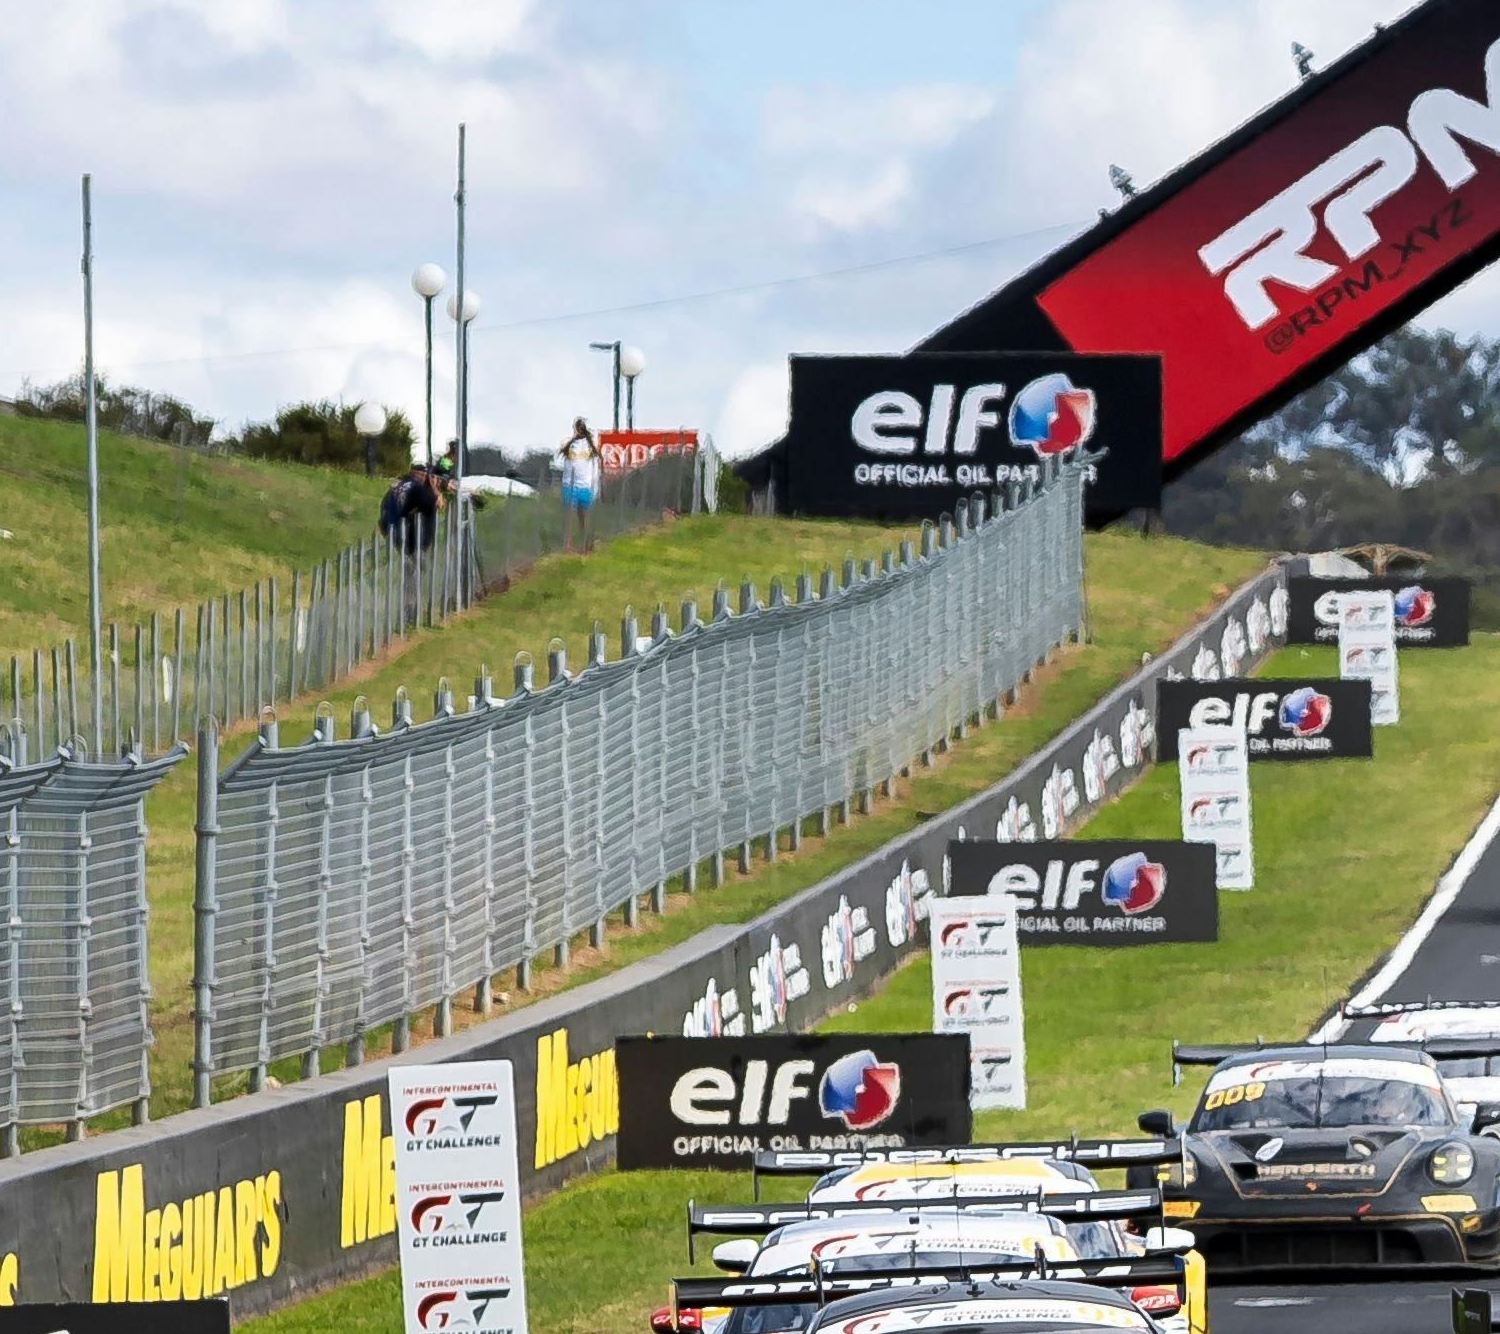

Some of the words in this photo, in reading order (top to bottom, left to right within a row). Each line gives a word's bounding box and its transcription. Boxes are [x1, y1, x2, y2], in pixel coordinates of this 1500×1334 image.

[1264, 198, 1473, 355] @RPM_XYZ
[851, 384, 1007, 455] elf
[854, 465, 949, 485] OFFICIAL
[956, 466, 990, 485] OIL
[1189, 692, 1280, 735] elf
[988, 859, 1100, 911] elf
[1063, 918, 1090, 932] OIL
[1093, 917, 1167, 932] PARTNER
[402, 1082, 498, 1095] INTERCONTINENTAL
[670, 1059, 814, 1125] elf
[1204, 1083, 1266, 1111] 009
[406, 1139, 423, 1152] GT
[426, 1134, 502, 1150] CHALLENGE
[674, 1135, 763, 1156] OFFICIAL
[770, 1135, 803, 1152] OIL
[408, 1179, 505, 1193] INTERCONTINENTAL
[93, 1162, 281, 1304] MEGUIAR'S
[412, 1236, 429, 1248] GT
[432, 1231, 508, 1247] CHALLENGE
[415, 1275, 511, 1289] INTERCONTINENTAL
